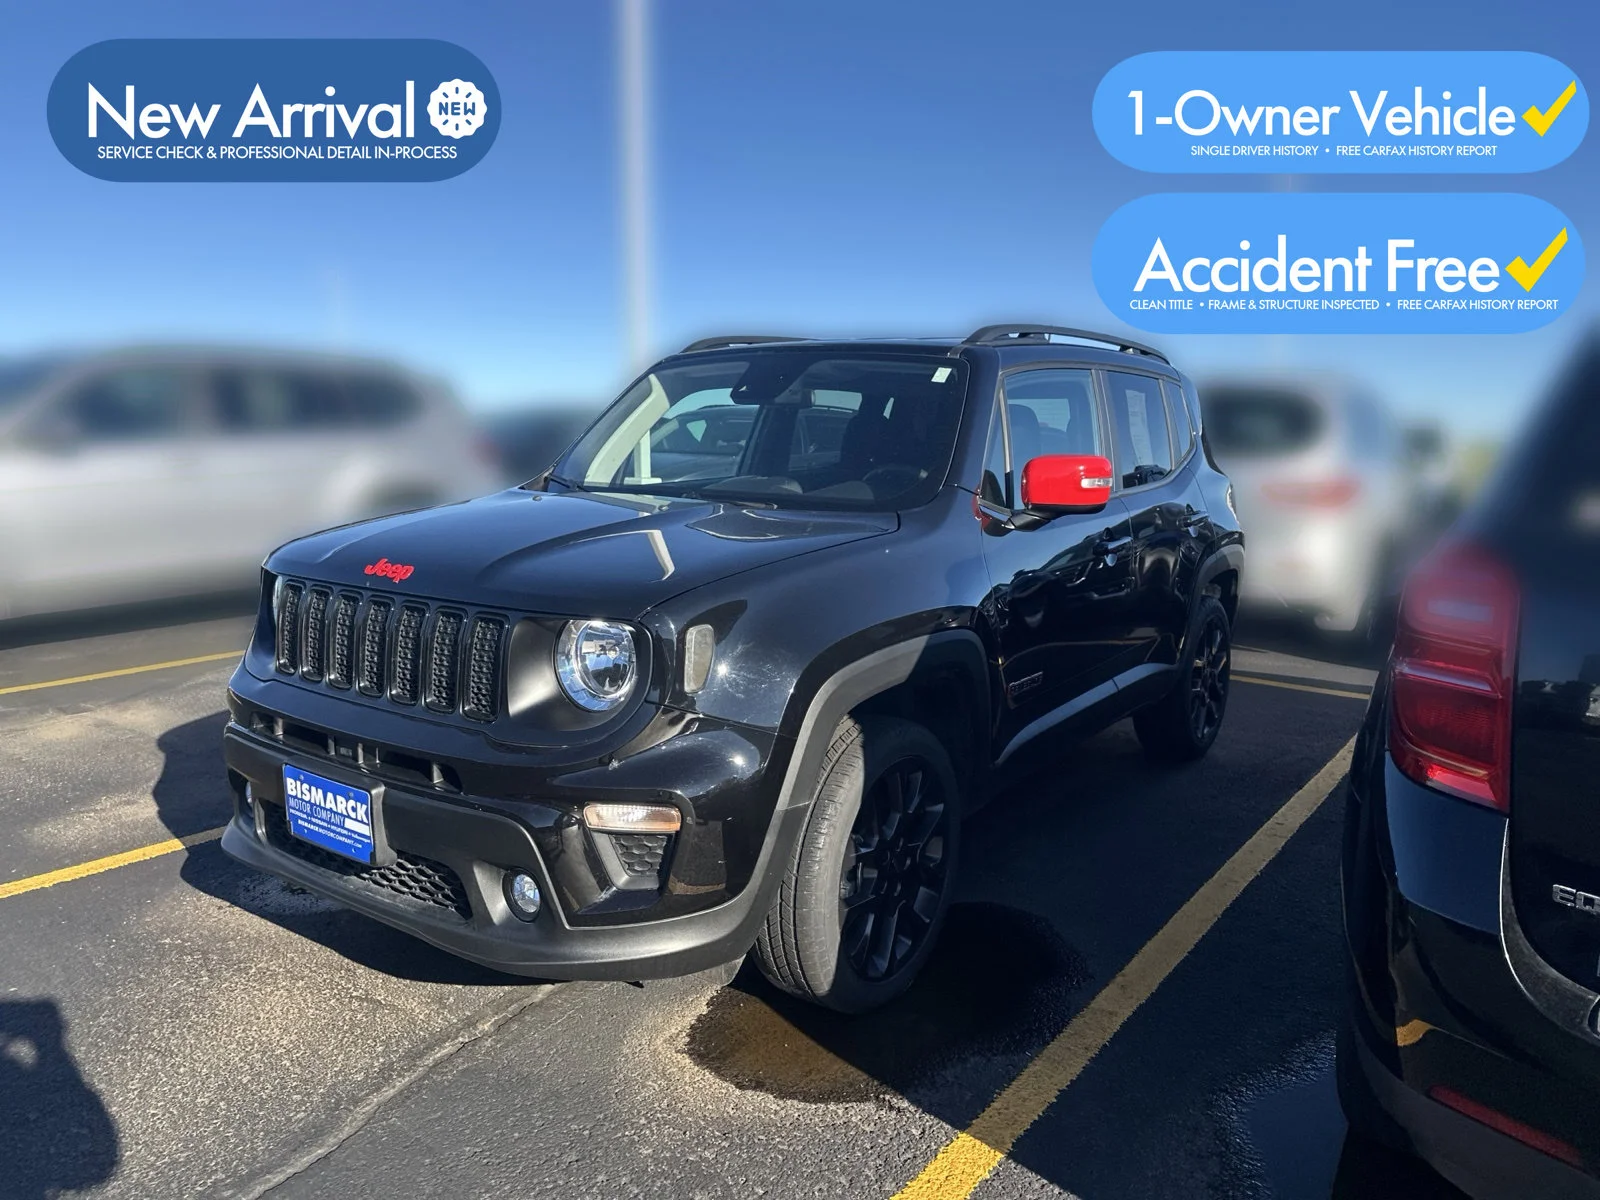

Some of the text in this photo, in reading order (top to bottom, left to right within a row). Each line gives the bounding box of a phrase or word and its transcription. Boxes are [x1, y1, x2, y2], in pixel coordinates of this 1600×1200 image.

[364, 558, 415, 584] Jeep
[286, 777, 369, 824] BISMARCK
[288, 796, 311, 815] MOTOR
[312, 805, 346, 828] COMPANY
